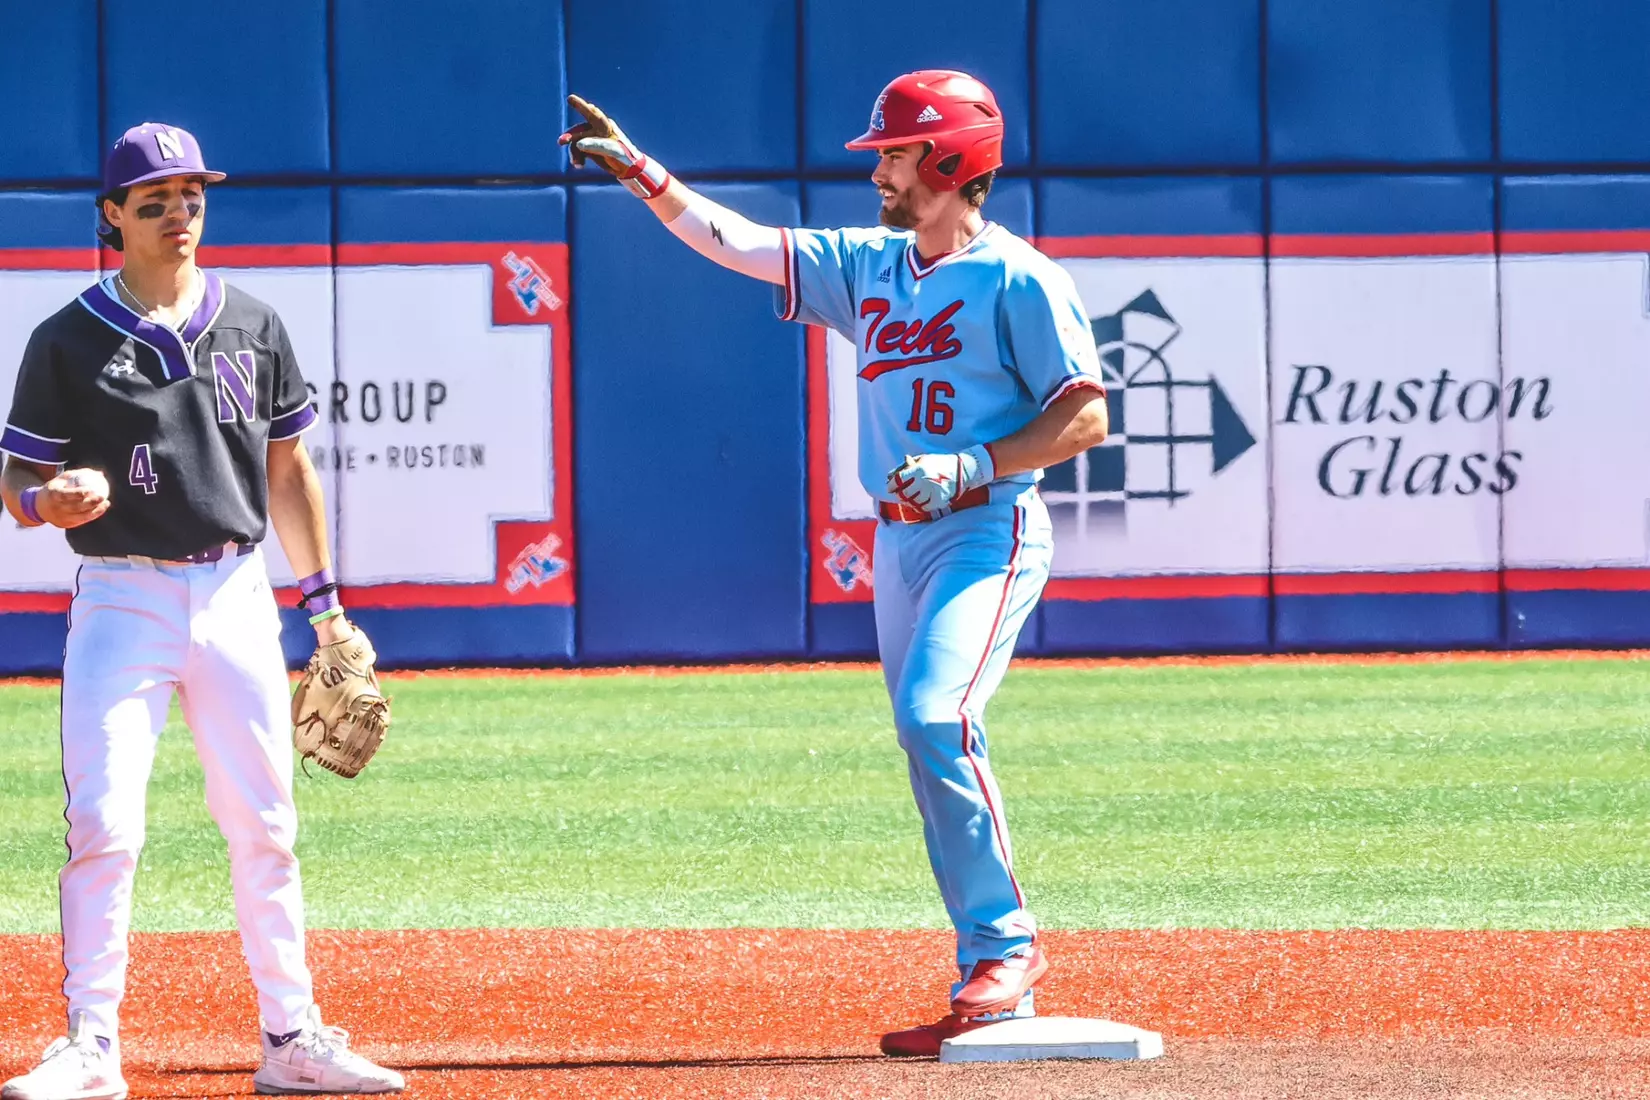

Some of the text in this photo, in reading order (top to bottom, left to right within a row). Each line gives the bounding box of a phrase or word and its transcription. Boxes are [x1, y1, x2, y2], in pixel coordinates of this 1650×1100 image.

[153, 130, 185, 161] N
[857, 297, 965, 382] Tech
[211, 350, 256, 423] N
[906, 377, 955, 435] 16
[1276, 364, 1554, 424] Ruston
[129, 443, 158, 495] 4
[386, 444, 487, 469] RUSTON
[1317, 435, 1523, 499] Glass
